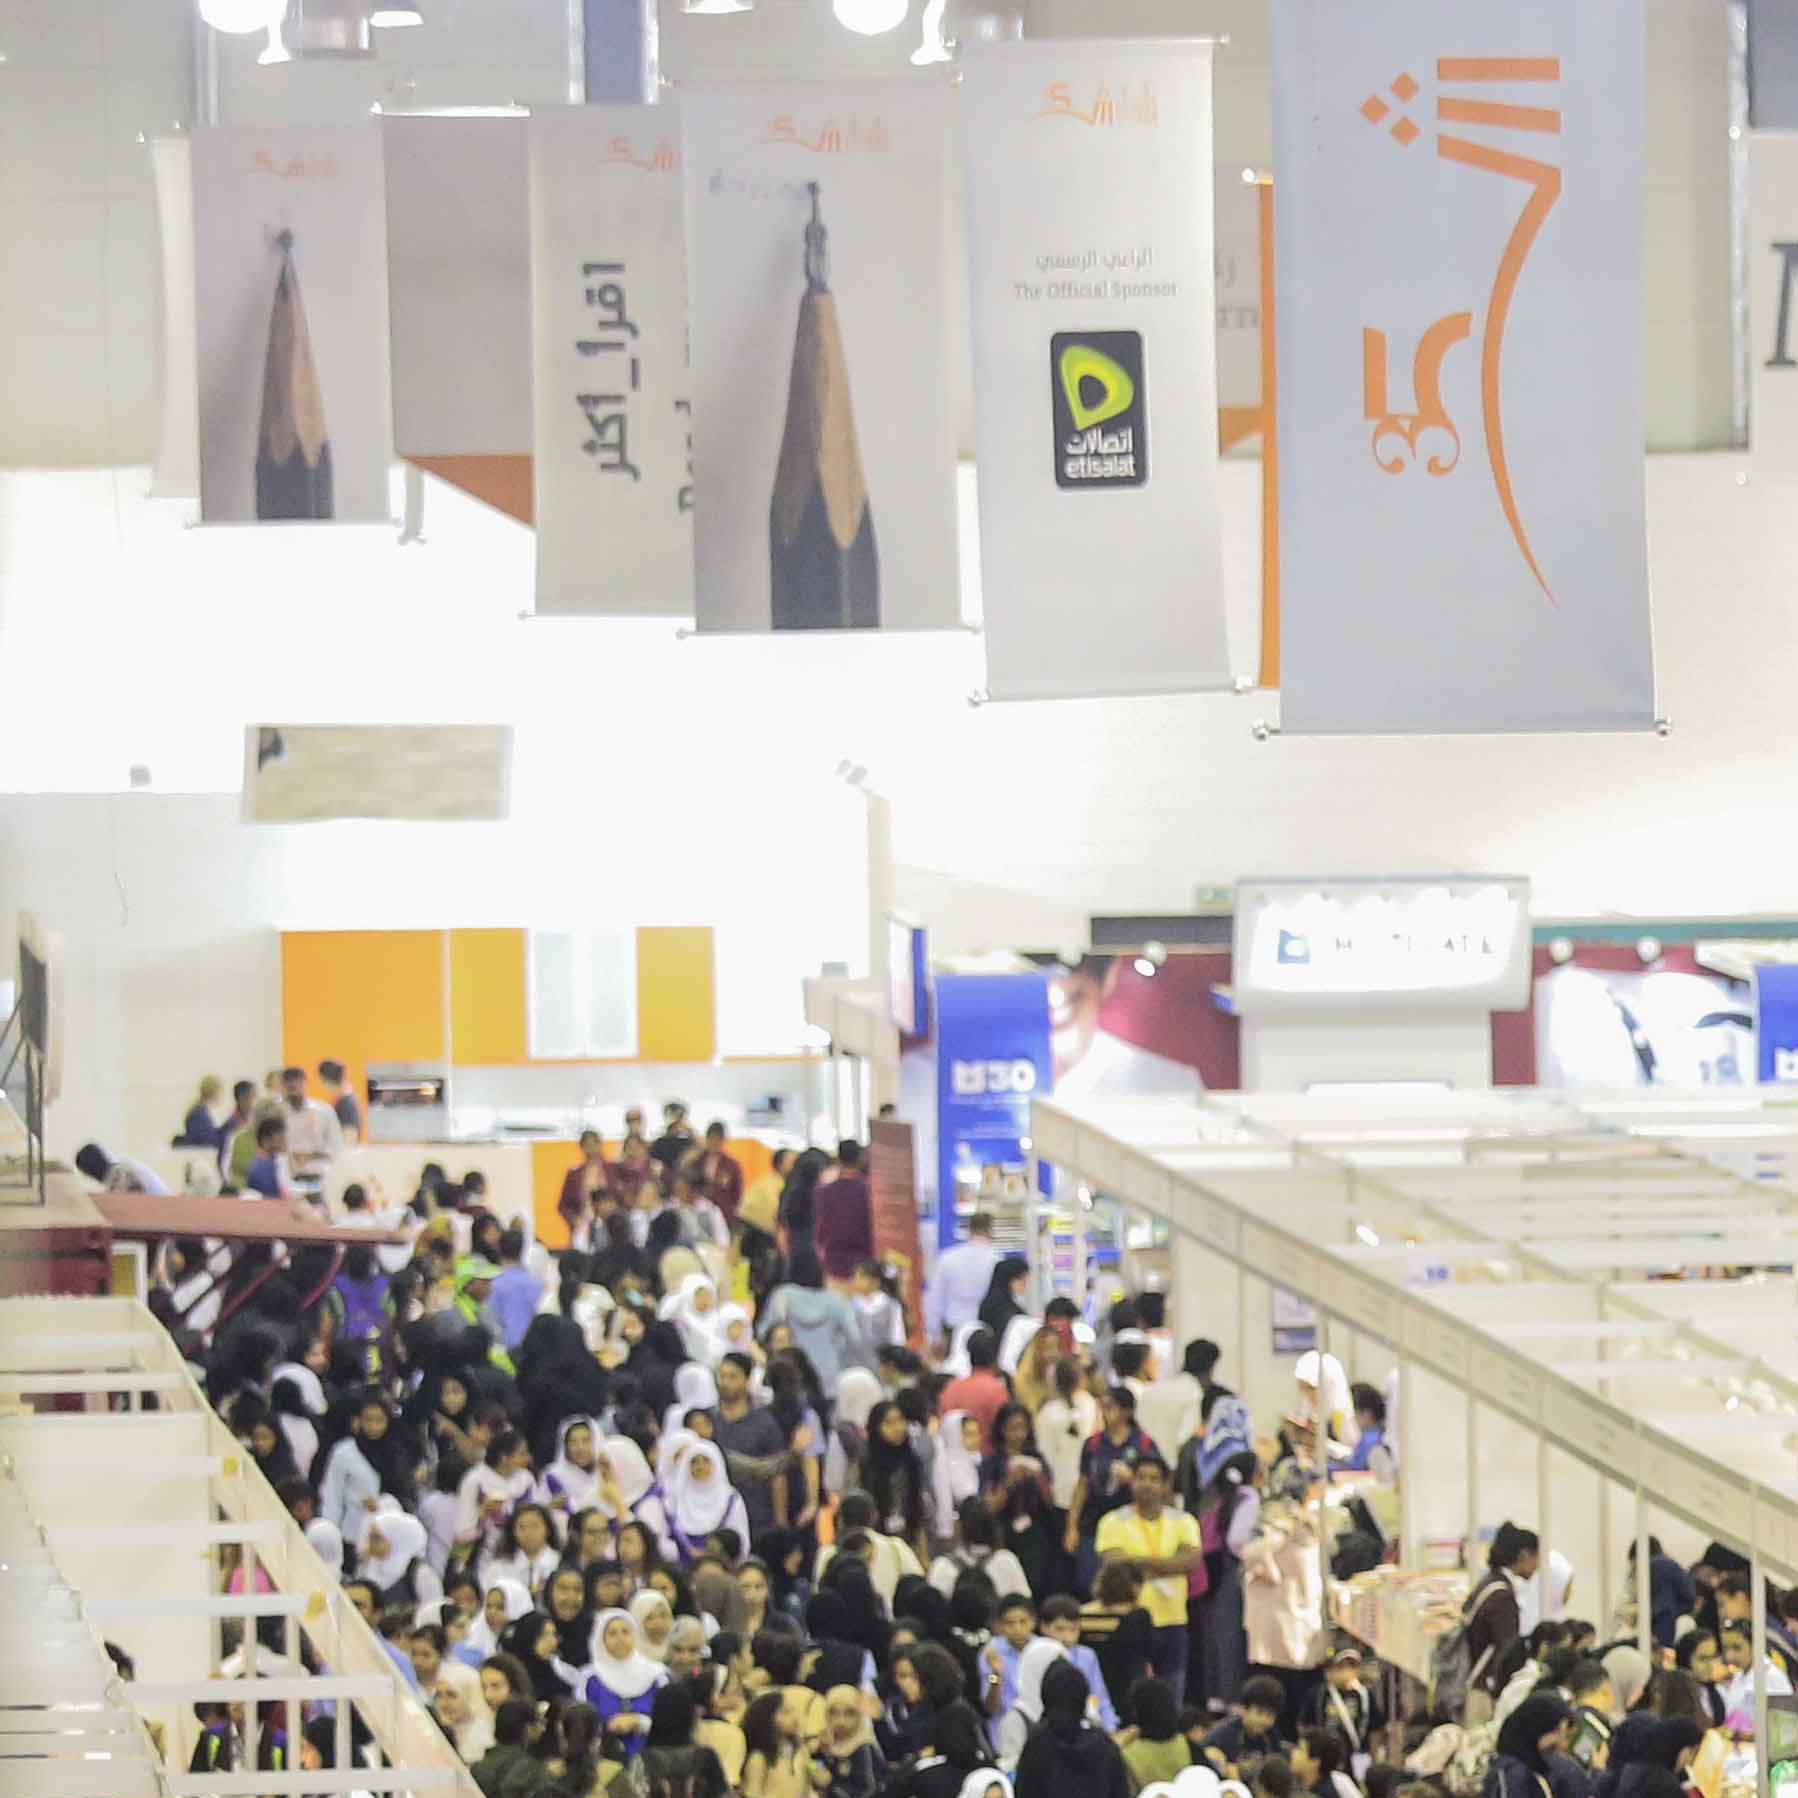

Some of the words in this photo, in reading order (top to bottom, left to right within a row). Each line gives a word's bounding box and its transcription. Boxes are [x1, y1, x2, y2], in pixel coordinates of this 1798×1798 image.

[1013, 283, 1043, 300] The
[1046, 281, 1108, 300] Official
[1110, 281, 1178, 302] Sponsor
[1064, 456, 1136, 480] etisalat
